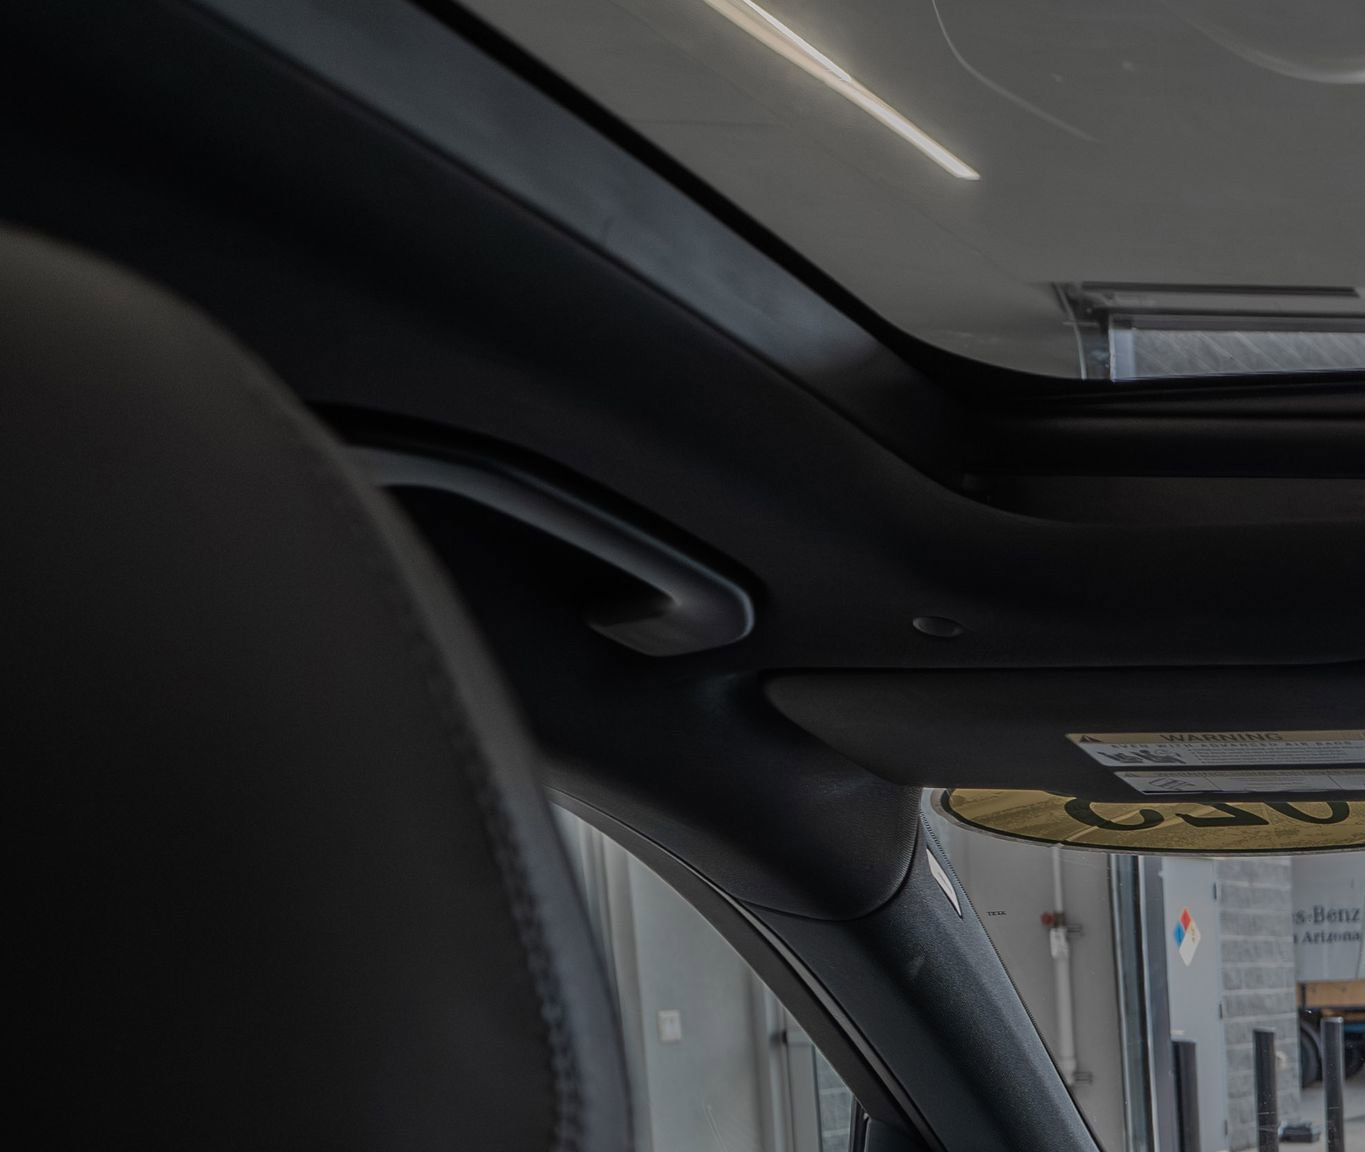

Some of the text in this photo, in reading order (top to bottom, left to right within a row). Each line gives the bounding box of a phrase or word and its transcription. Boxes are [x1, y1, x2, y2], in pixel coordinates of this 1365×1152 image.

[1160, 733, 1283, 742] WARNING
[1292, 904, 1361, 924] s-Benz
[1302, 930, 1362, 945] Arizona
